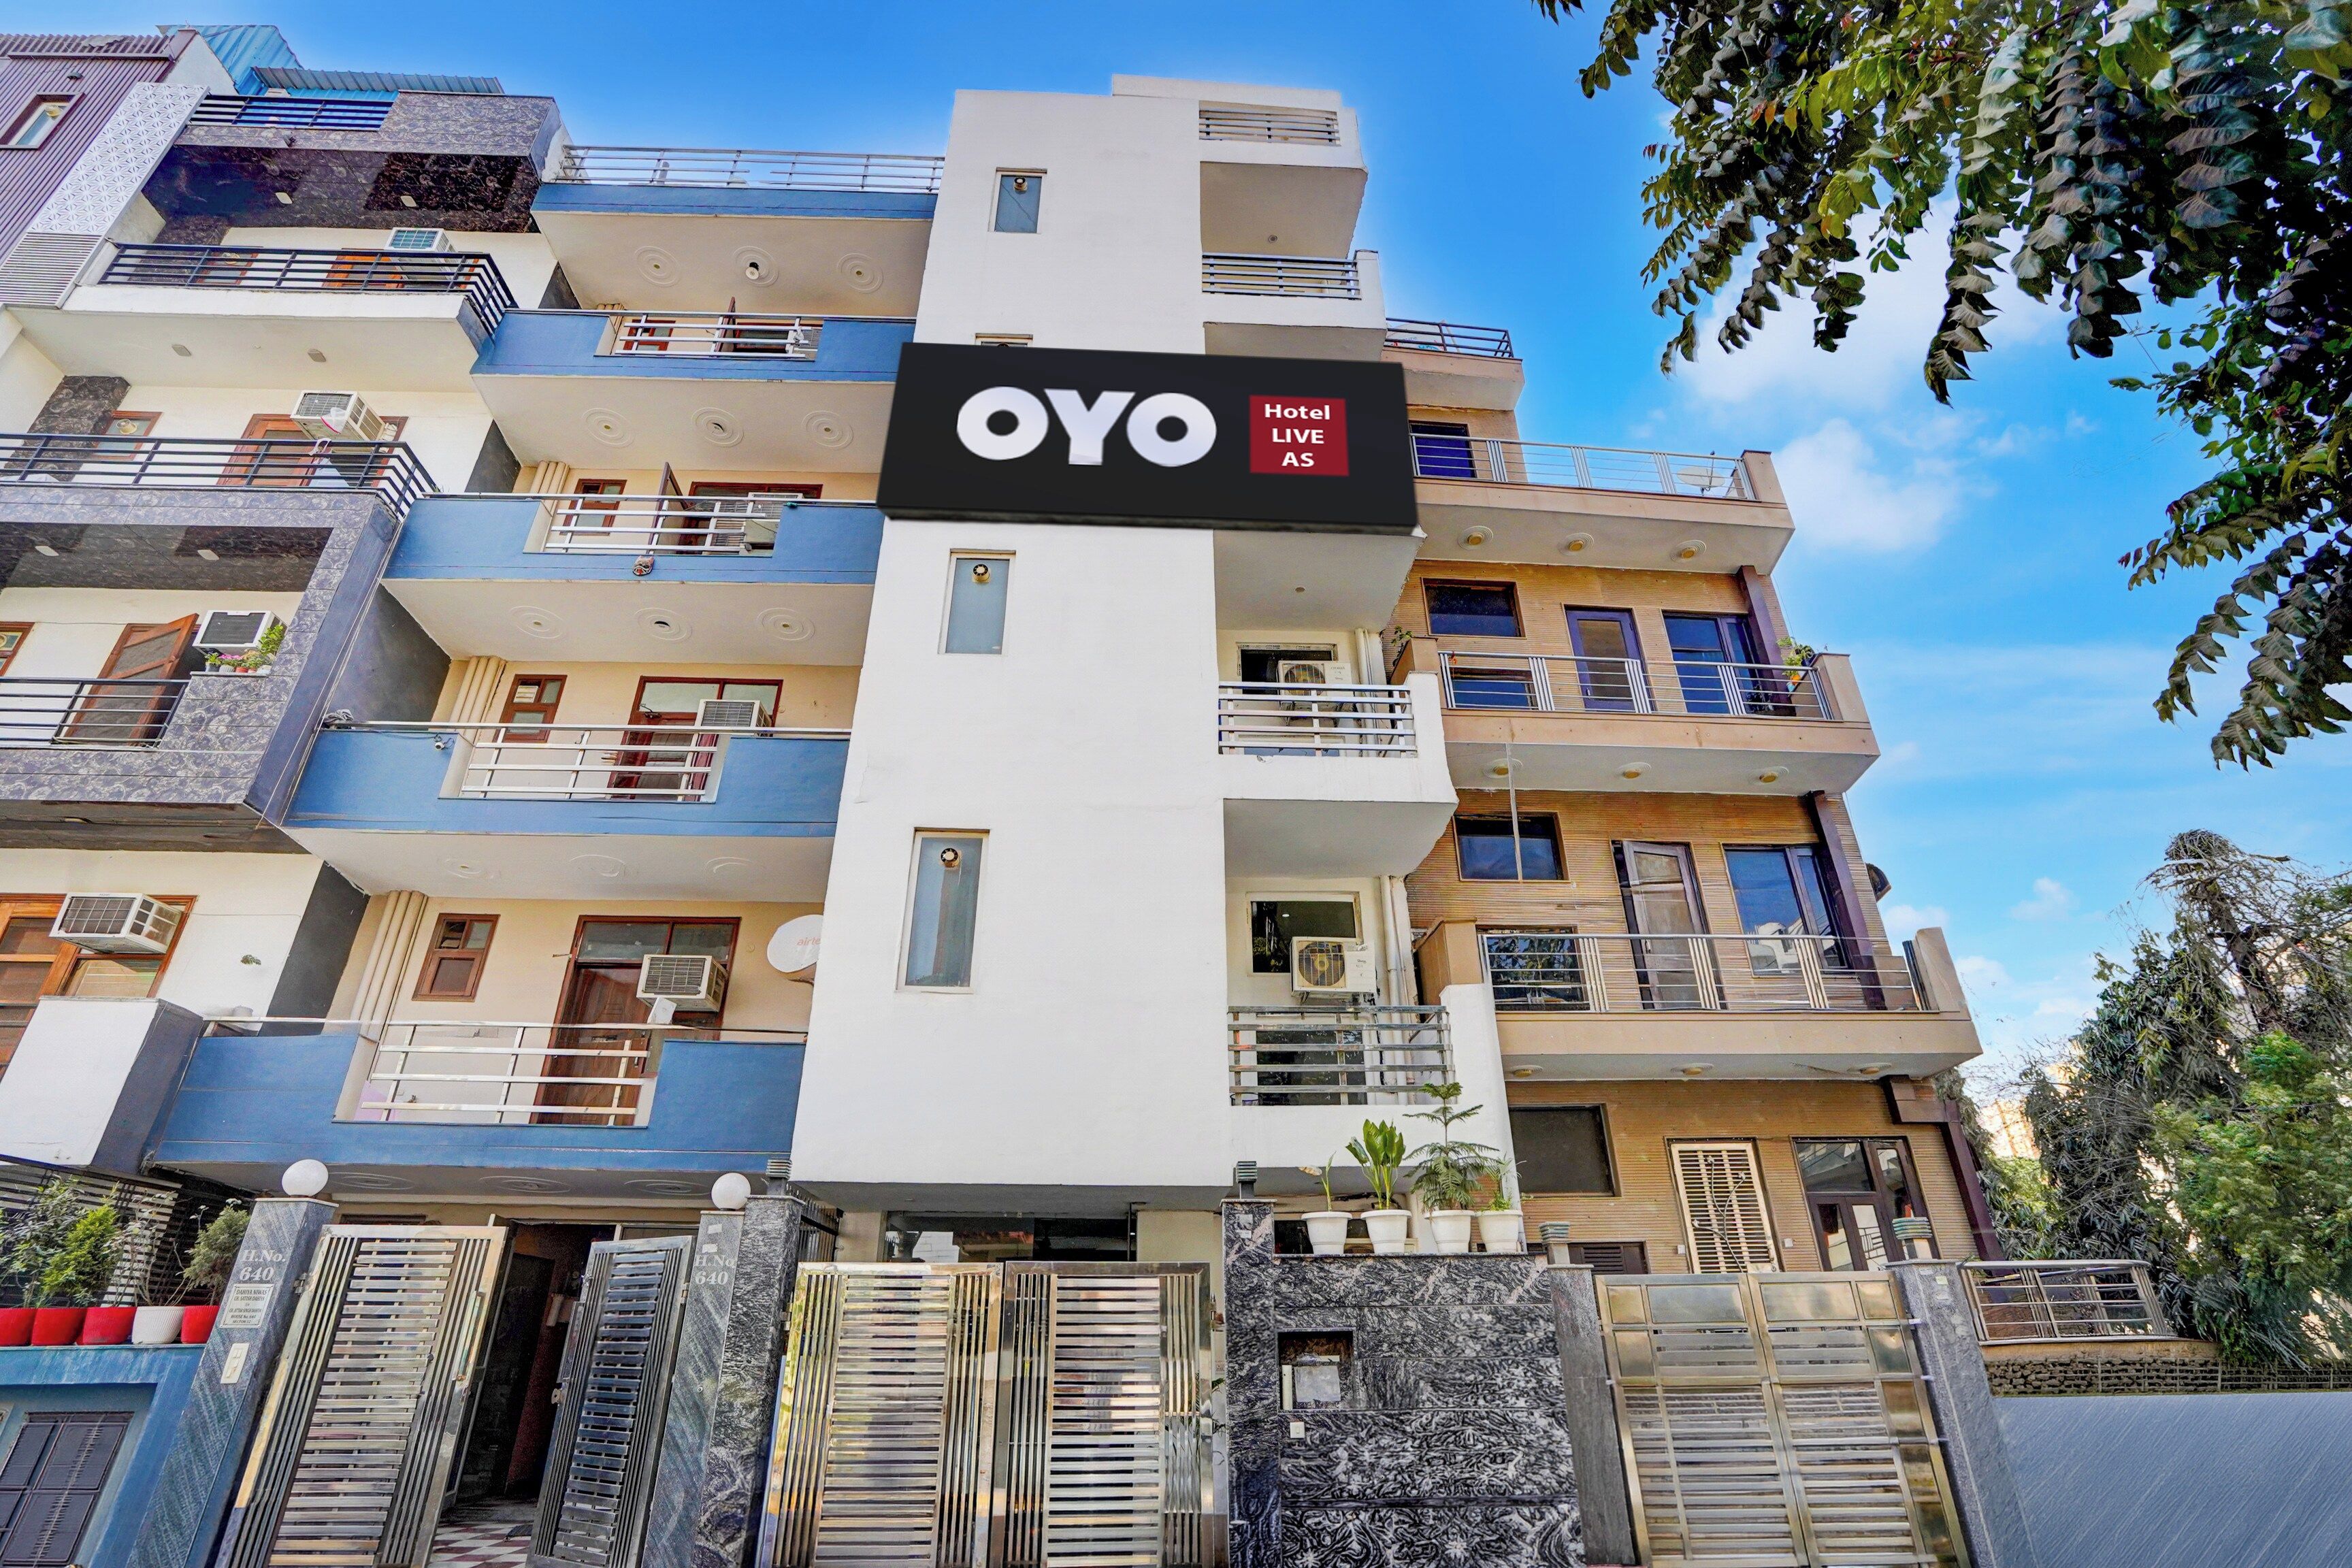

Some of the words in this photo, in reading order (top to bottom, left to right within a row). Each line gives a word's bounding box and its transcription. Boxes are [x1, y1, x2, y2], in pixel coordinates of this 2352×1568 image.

[1264, 404, 1330, 420] Hotel
[957, 386, 1217, 467] OYO
[1272, 428, 1324, 444] LIVE
[1281, 452, 1314, 467] AS
[796, 937, 821, 947] airte
[241, 1250, 286, 1262] H.No.
[240, 1267, 274, 1280] 640
[695, 1271, 728, 1285] 640
